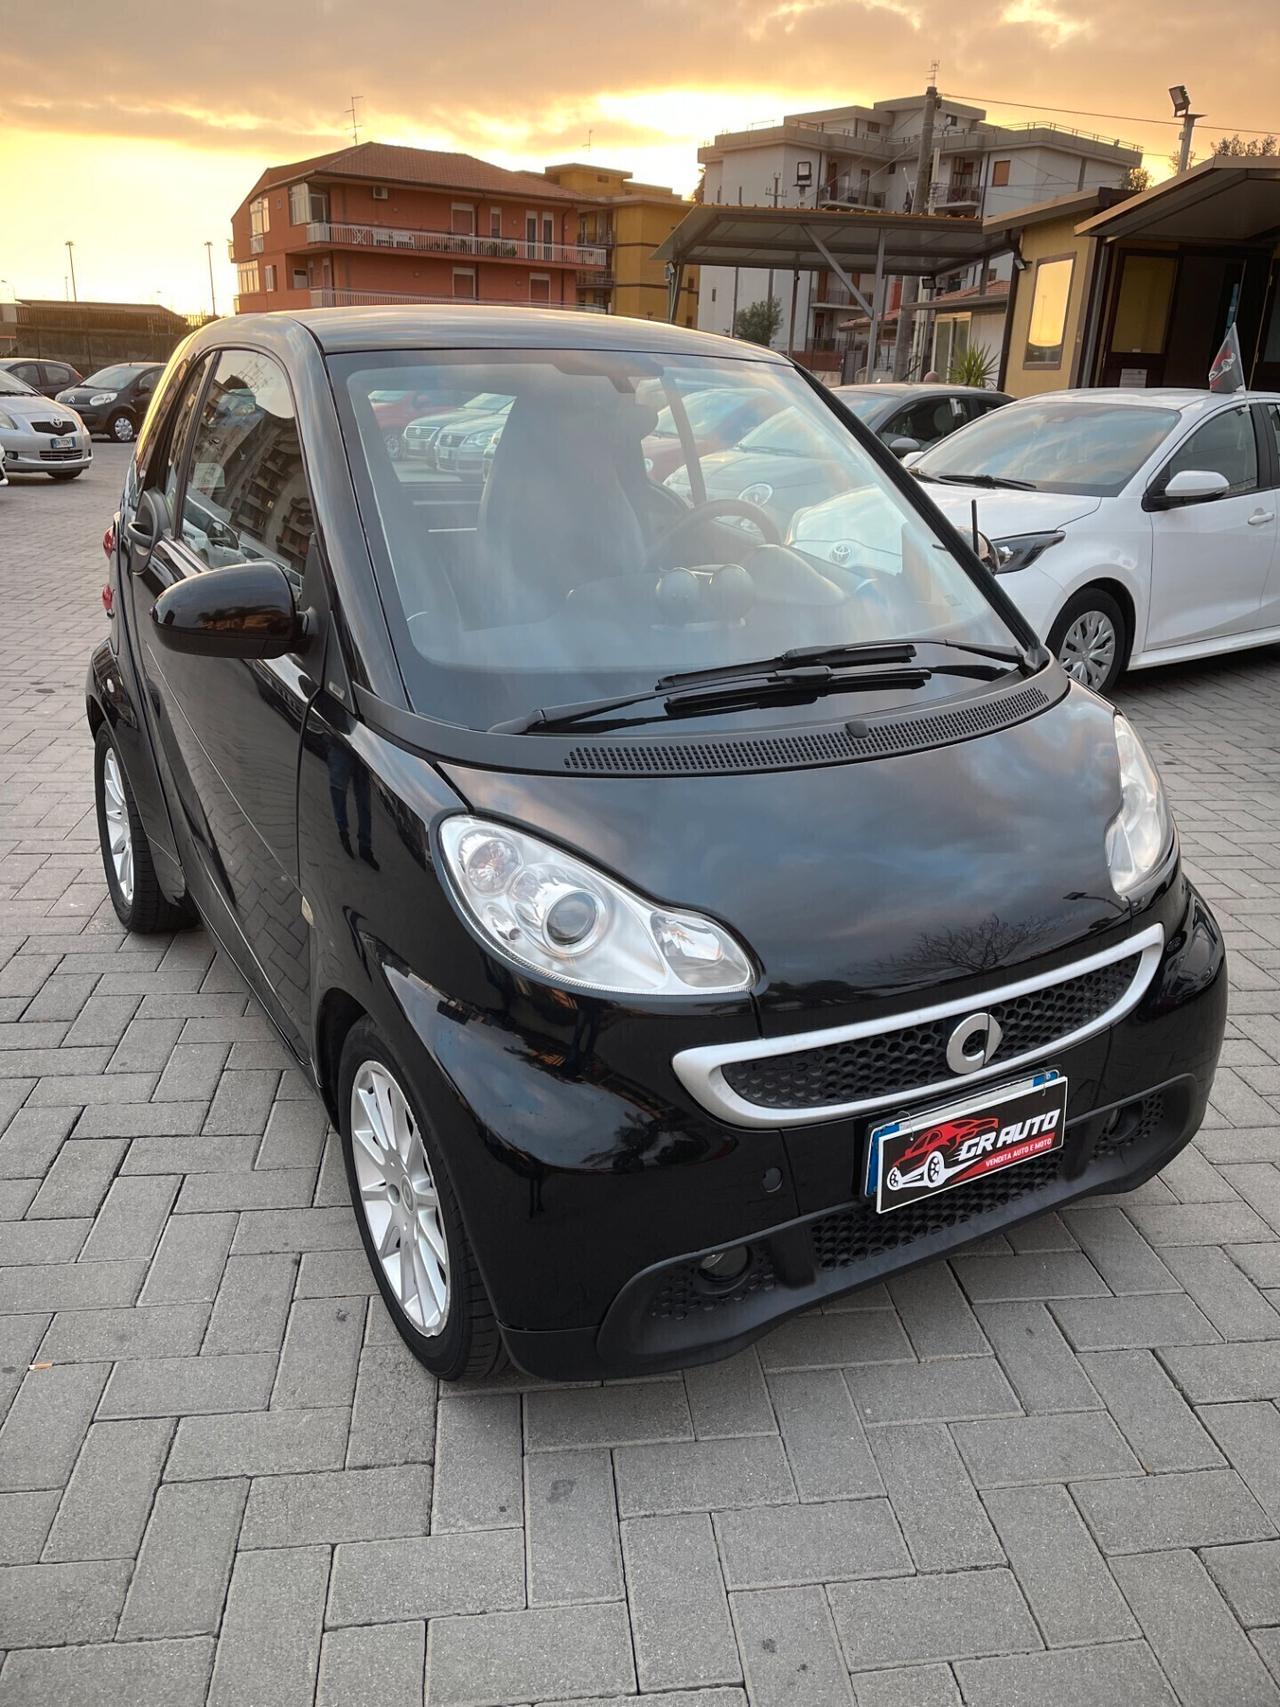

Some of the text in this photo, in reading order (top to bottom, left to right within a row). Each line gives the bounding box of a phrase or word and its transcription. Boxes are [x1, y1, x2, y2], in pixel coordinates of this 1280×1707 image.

[959, 1109, 1061, 1161] GR AUTO
[985, 1138, 1052, 1167] VENDITA AUTO E MOTO
